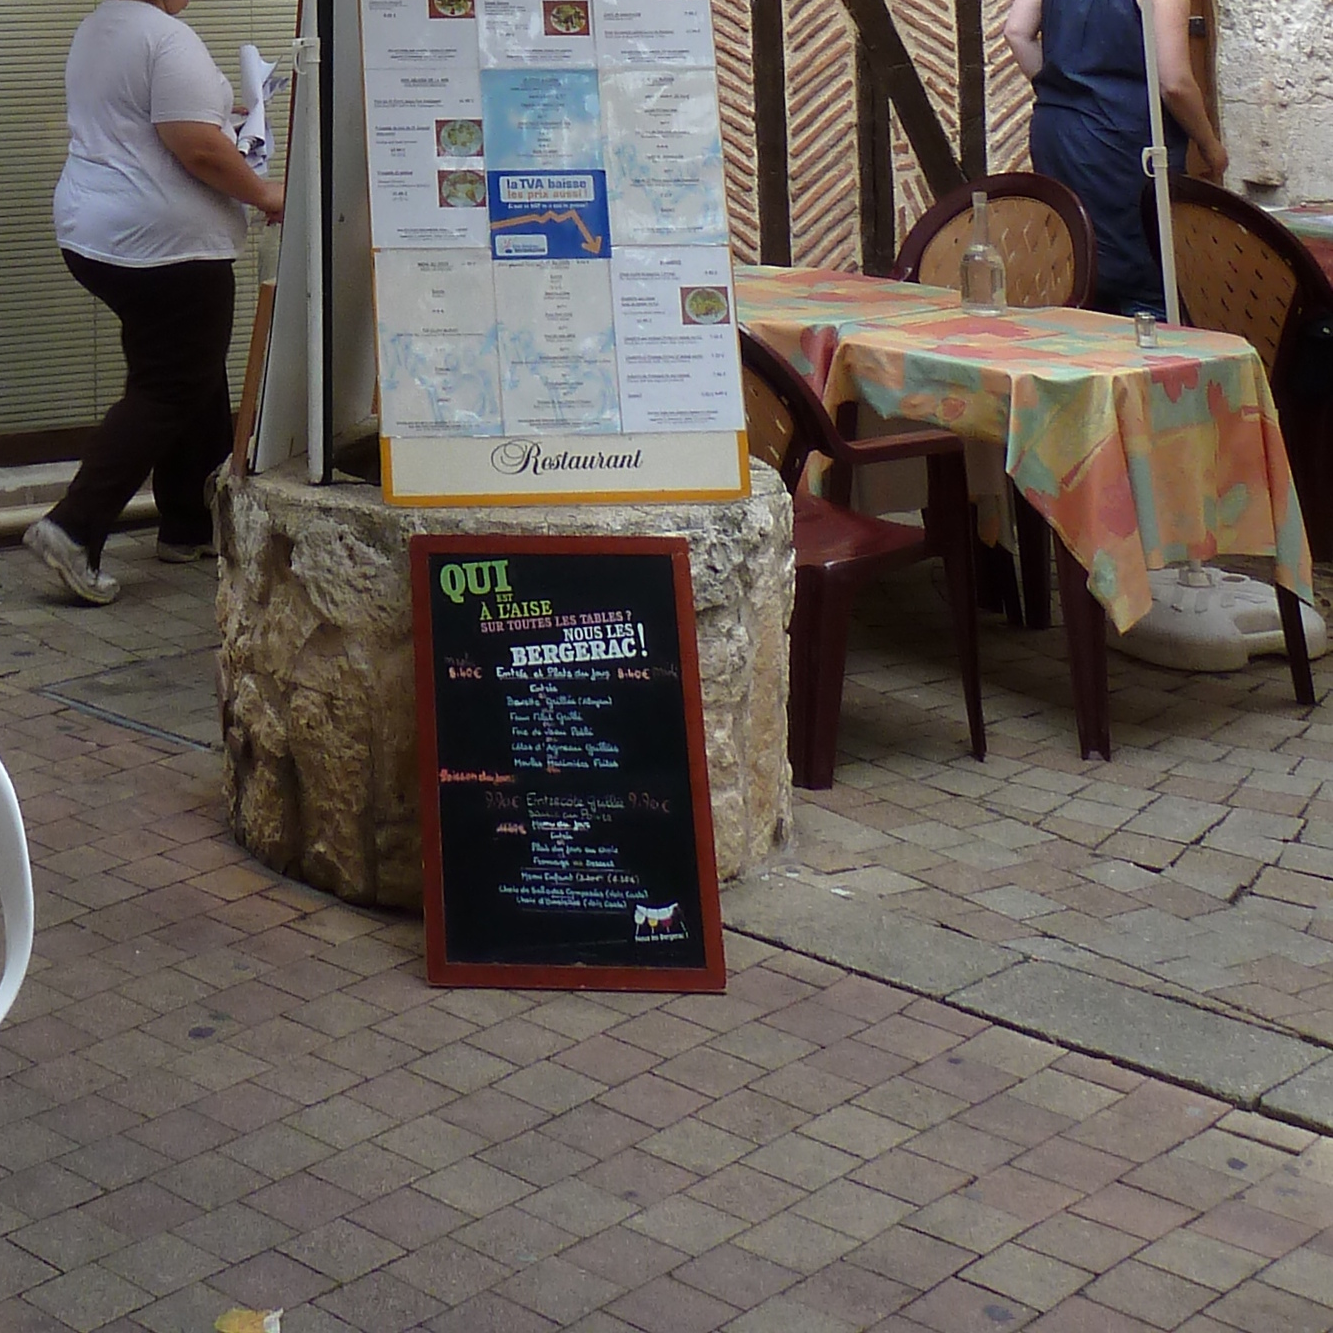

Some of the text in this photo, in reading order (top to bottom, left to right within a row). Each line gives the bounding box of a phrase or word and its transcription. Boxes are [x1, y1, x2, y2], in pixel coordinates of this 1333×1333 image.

[507, 178, 587, 189] la TVA baisse
[507, 190, 523, 199] les
[527, 190, 548, 200] prix
[491, 439, 643, 475] Restaurant
[440, 560, 512, 603] QUI
[496, 593, 513, 603] EST
[479, 600, 552, 620] À L'AISE
[481, 620, 504, 633] SUR
[506, 617, 552, 631] TOUTES
[555, 616, 577, 628] LES
[580, 611, 624, 624] TABLES
[563, 623, 635, 642] NOUS LES
